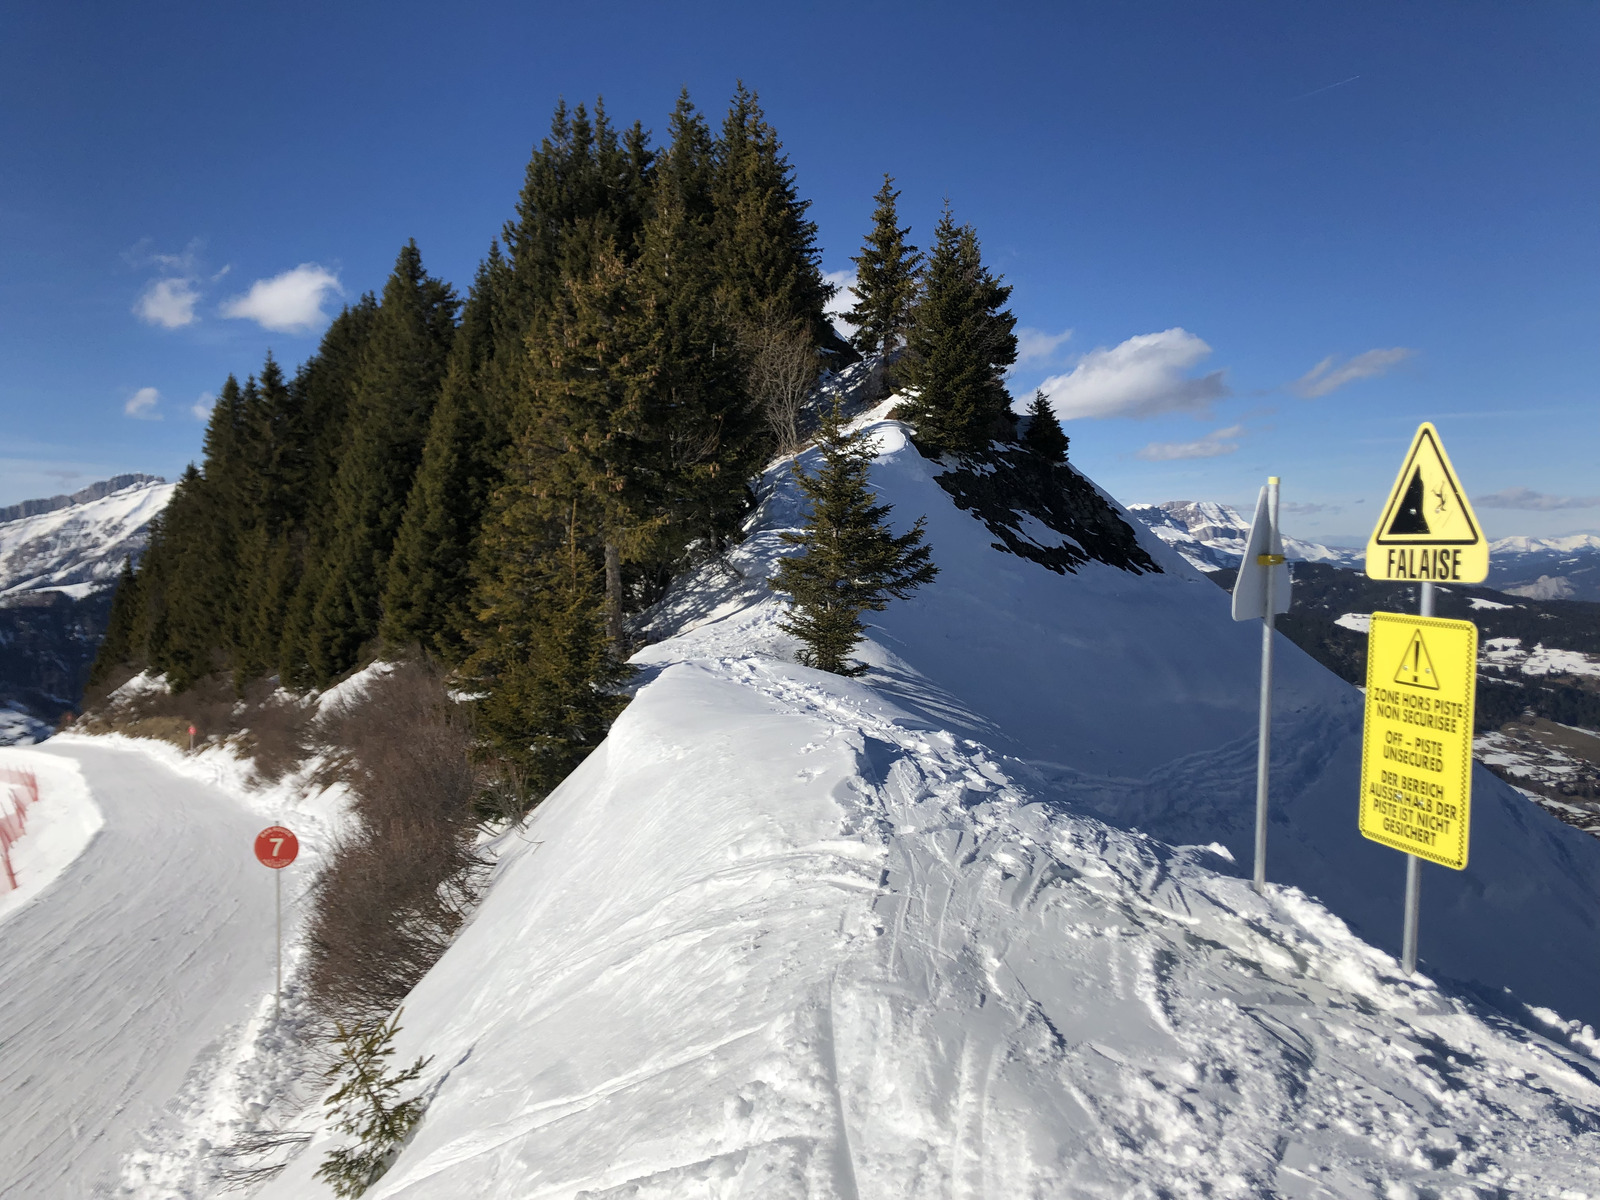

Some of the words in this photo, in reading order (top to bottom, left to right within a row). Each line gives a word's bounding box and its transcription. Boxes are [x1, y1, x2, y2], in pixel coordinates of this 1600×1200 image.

[1387, 548, 1462, 580] FALAISE
[1374, 687, 1399, 705] ZONE
[1402, 692, 1431, 712] HORS
[1434, 699, 1463, 718] PISTE
[1376, 703, 1400, 721] NON
[1403, 709, 1457, 733] SECURISEE
[1383, 745, 1443, 772] UNSECURED
[1385, 730, 1403, 746] OFF
[1415, 737, 1443, 757] PISTE
[1381, 769, 1398, 787] DER
[1401, 776, 1444, 800] BEREICH
[1369, 782, 1433, 813] AUSSERHALB
[1436, 801, 1457, 820] DER
[1373, 798, 1397, 818] PISTE
[1400, 807, 1414, 823] IST
[1417, 812, 1450, 834] NICHT
[1383, 817, 1436, 846] GESICHERT
[269, 838, 284, 857] 7
